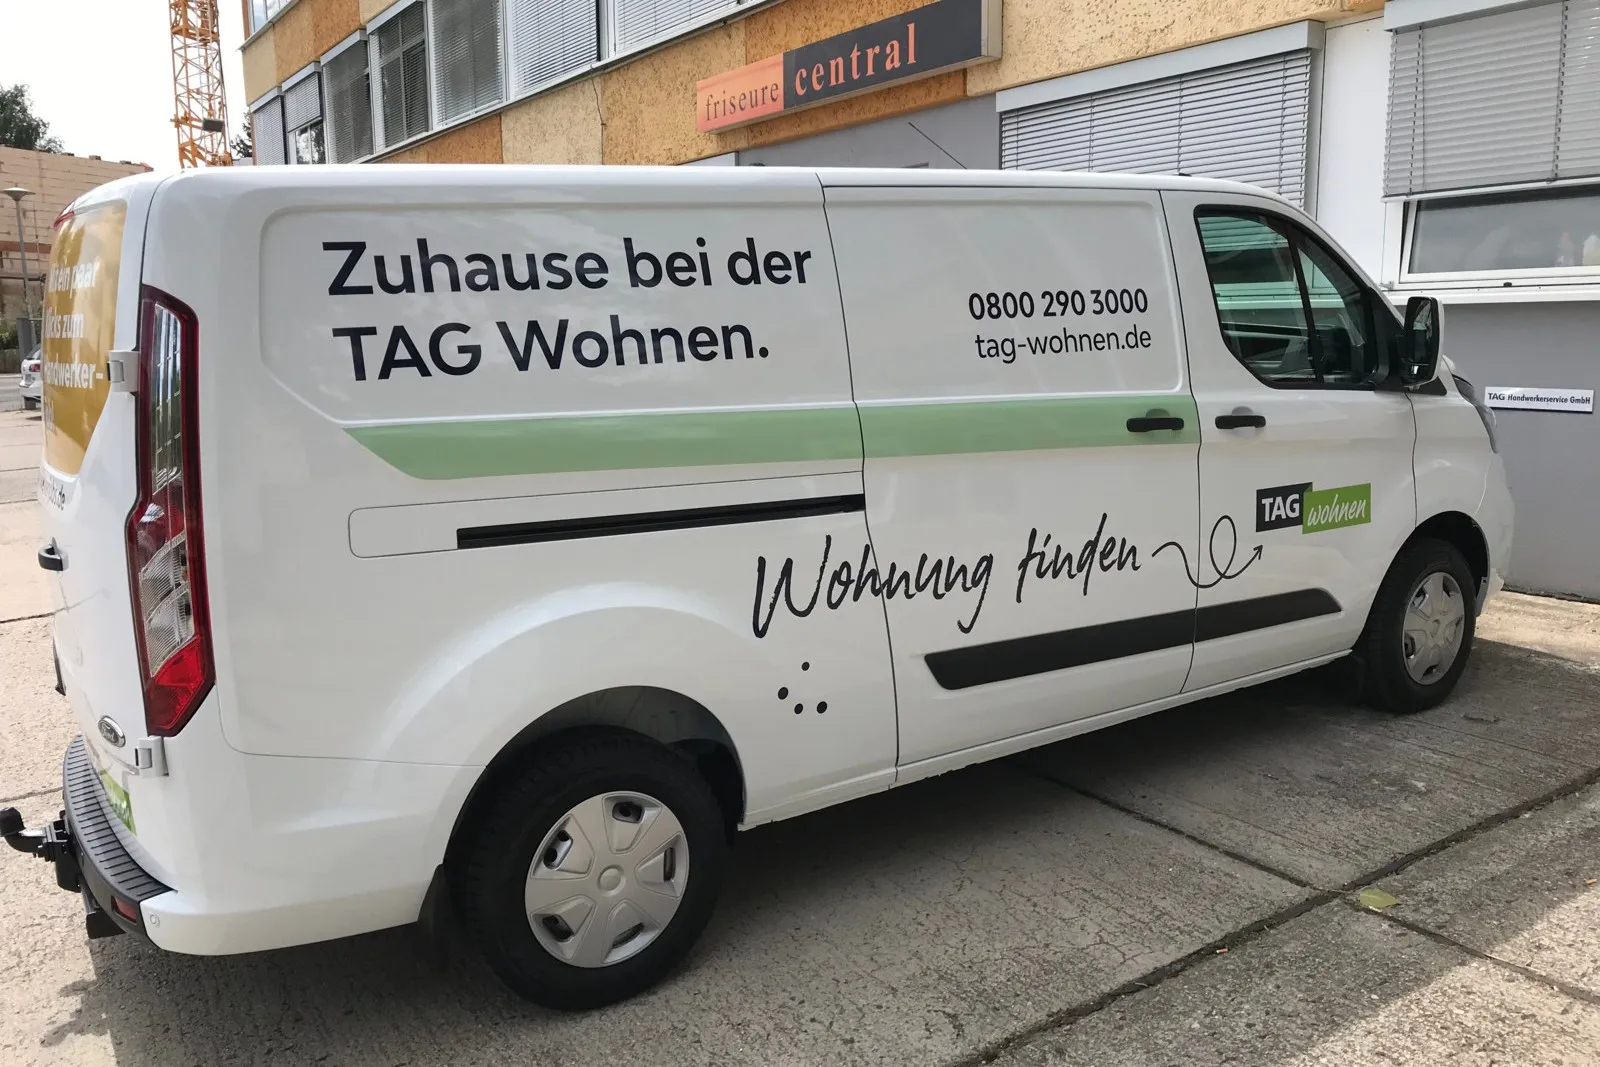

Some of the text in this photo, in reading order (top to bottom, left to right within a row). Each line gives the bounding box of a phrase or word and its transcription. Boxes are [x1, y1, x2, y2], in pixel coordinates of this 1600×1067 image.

[704, 21, 917, 122] friseure central
[70, 259, 99, 299] paar
[321, 236, 812, 296] Zuhause bei der
[968, 288, 1149, 320] 0800 290 3000
[62, 311, 84, 339] zum
[974, 323, 1152, 365] tag-wohnen.de
[331, 314, 770, 382] TAG Wohnen.
[45, 353, 104, 390] andwerker-
[1487, 392, 1591, 405] TAG Handwerkerservice GmbH
[1261, 493, 1366, 527] TAG wohnen
[752, 512, 1141, 640] Wohnung finden
